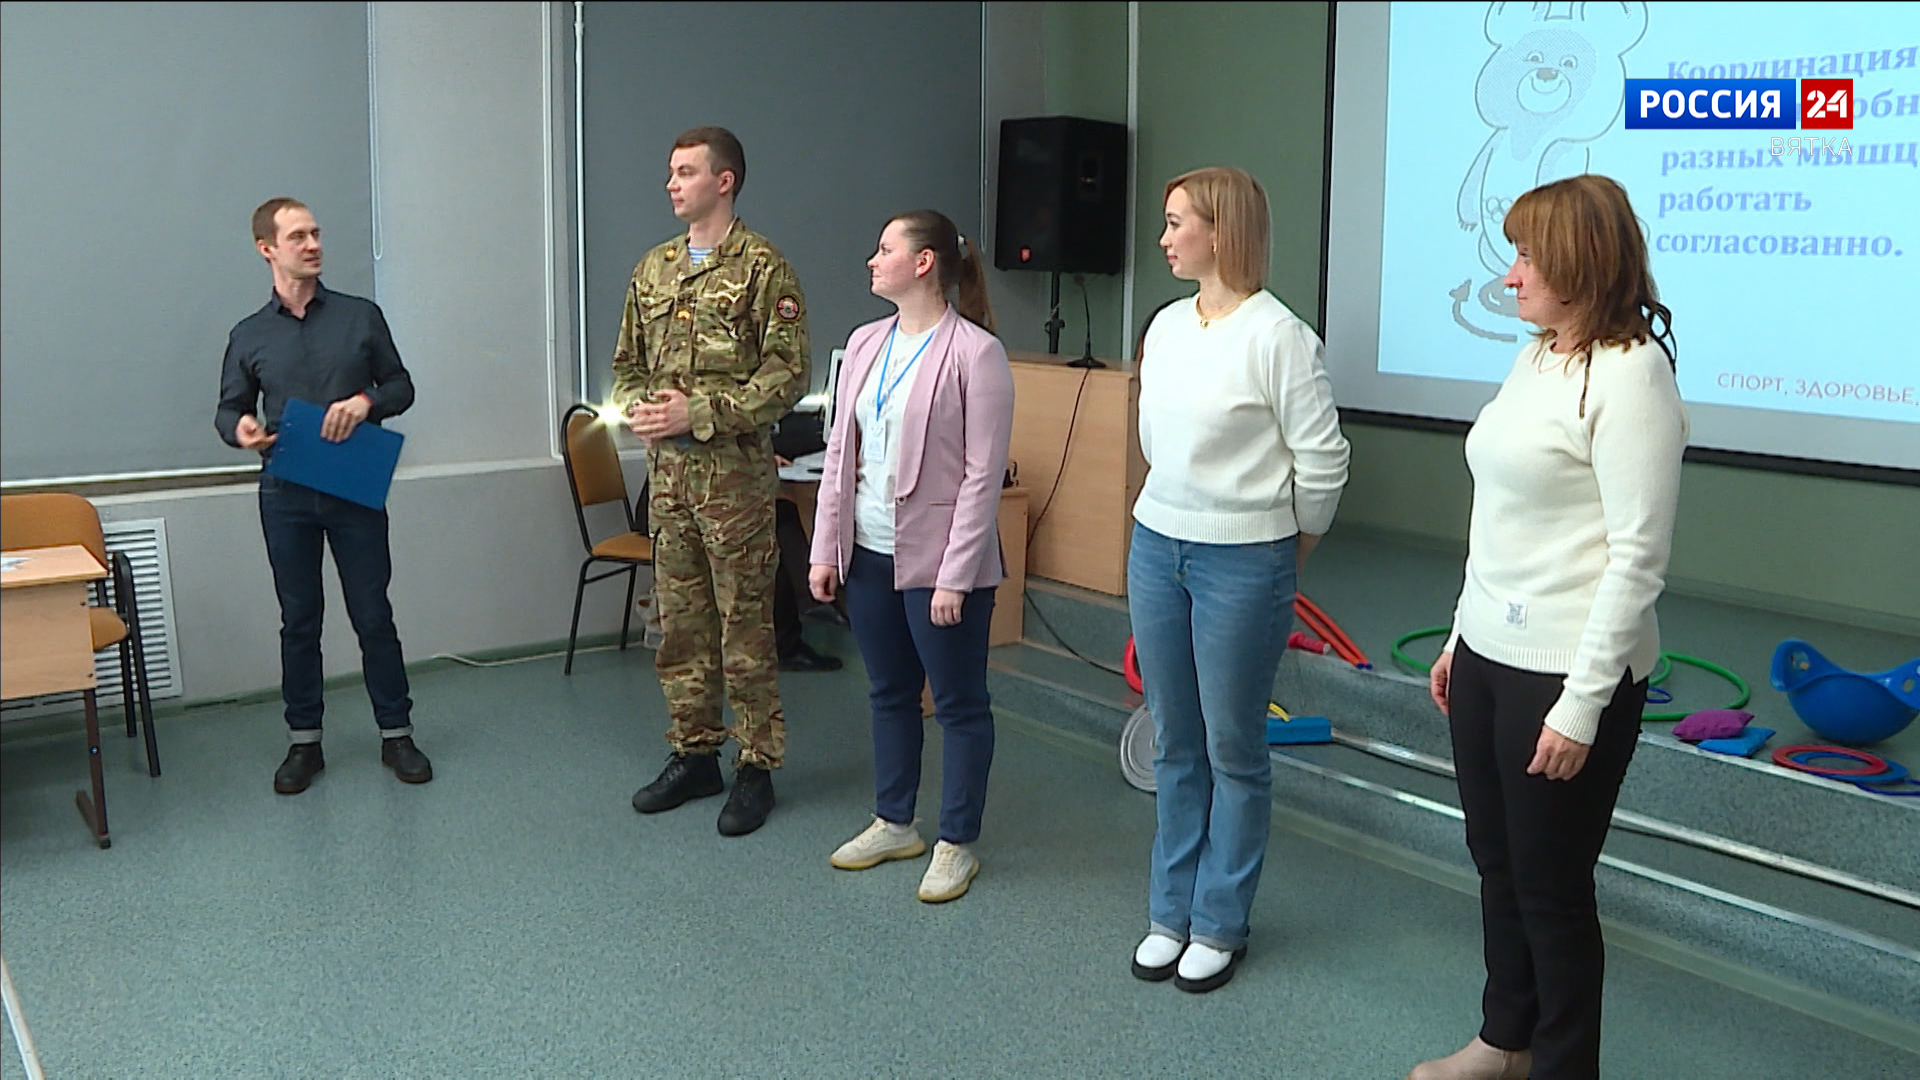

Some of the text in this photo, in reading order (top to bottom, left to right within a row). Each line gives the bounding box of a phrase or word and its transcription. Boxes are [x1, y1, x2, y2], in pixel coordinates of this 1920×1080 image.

[1667, 46, 1920, 79] Координация
[1661, 148, 1784, 176] разных
[1658, 186, 1812, 218] работать
[1655, 232, 1904, 257] согласованно.
[1717, 372, 1788, 395] СПОРТ,
